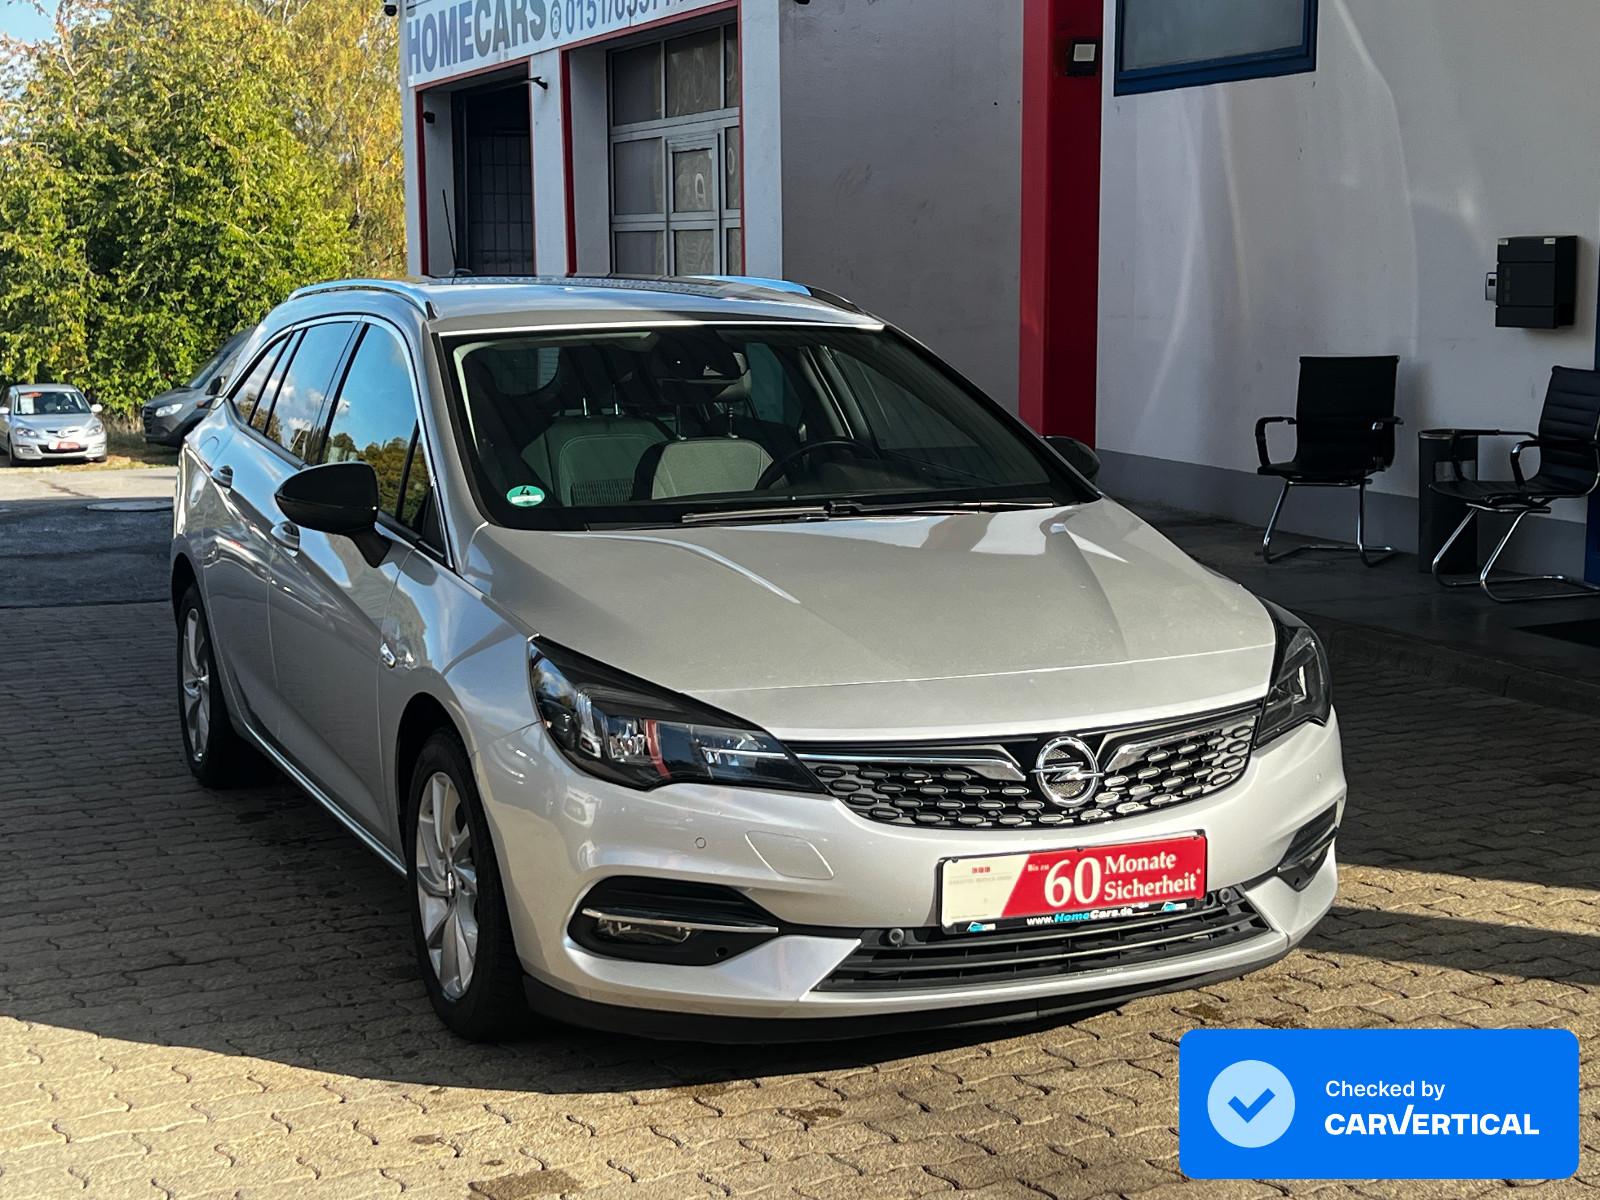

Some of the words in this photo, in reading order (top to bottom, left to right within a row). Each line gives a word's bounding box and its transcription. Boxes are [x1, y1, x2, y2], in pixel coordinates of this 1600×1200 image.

[407, 0, 547, 76] HOMECARS
[520, 486, 530, 496] 4
[1105, 851, 1177, 875] Monate
[1044, 857, 1101, 907] 60
